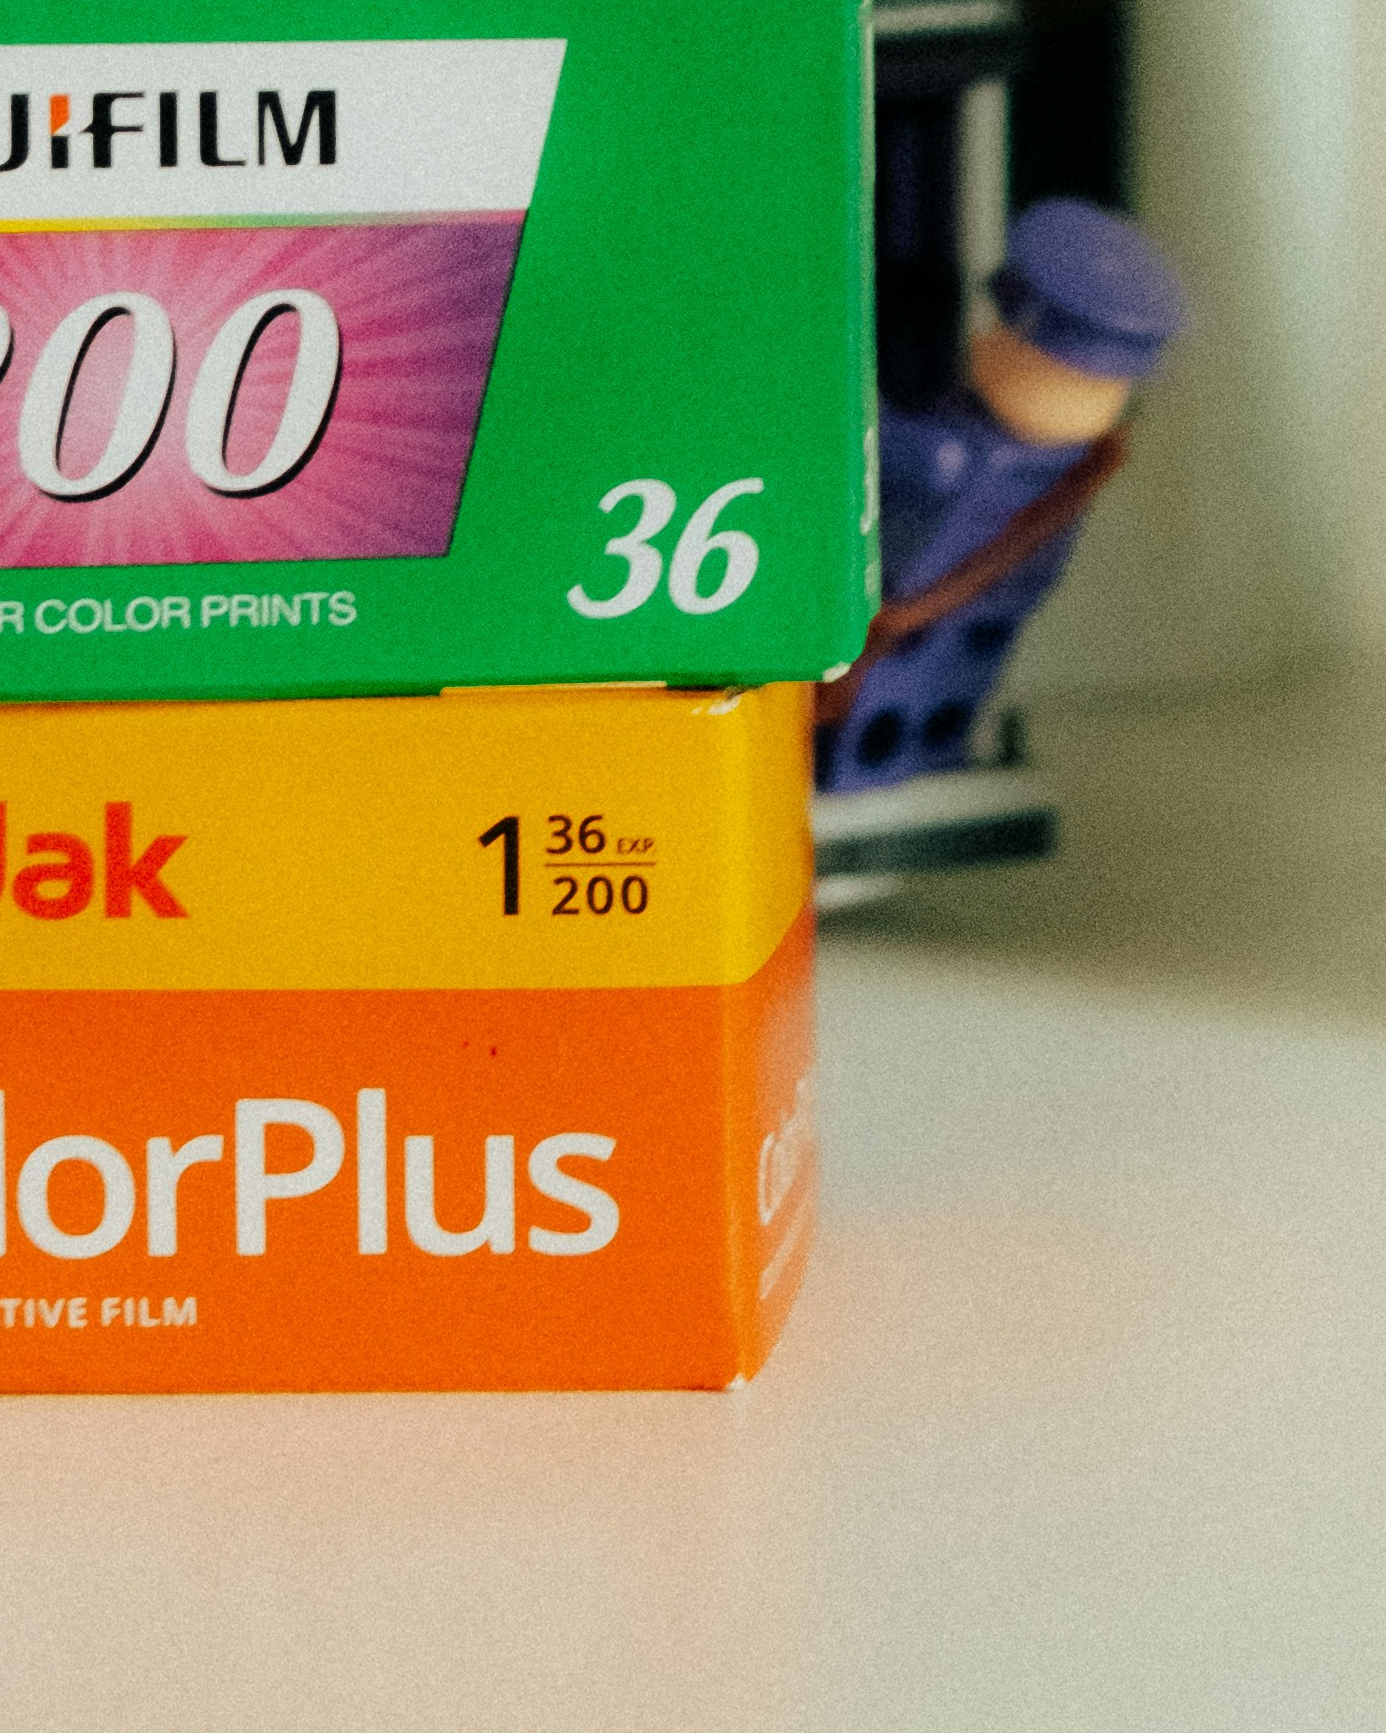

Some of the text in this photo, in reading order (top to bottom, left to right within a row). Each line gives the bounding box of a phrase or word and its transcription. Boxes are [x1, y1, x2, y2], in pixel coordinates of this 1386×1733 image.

[566, 477, 764, 620] 36
[33, 595, 192, 635] COLOR
[199, 590, 359, 630] PRINTS
[545, 813, 608, 856] 36
[477, 815, 521, 917] 1
[551, 874, 650, 917] 200
[99, 1295, 199, 1329] FILM
